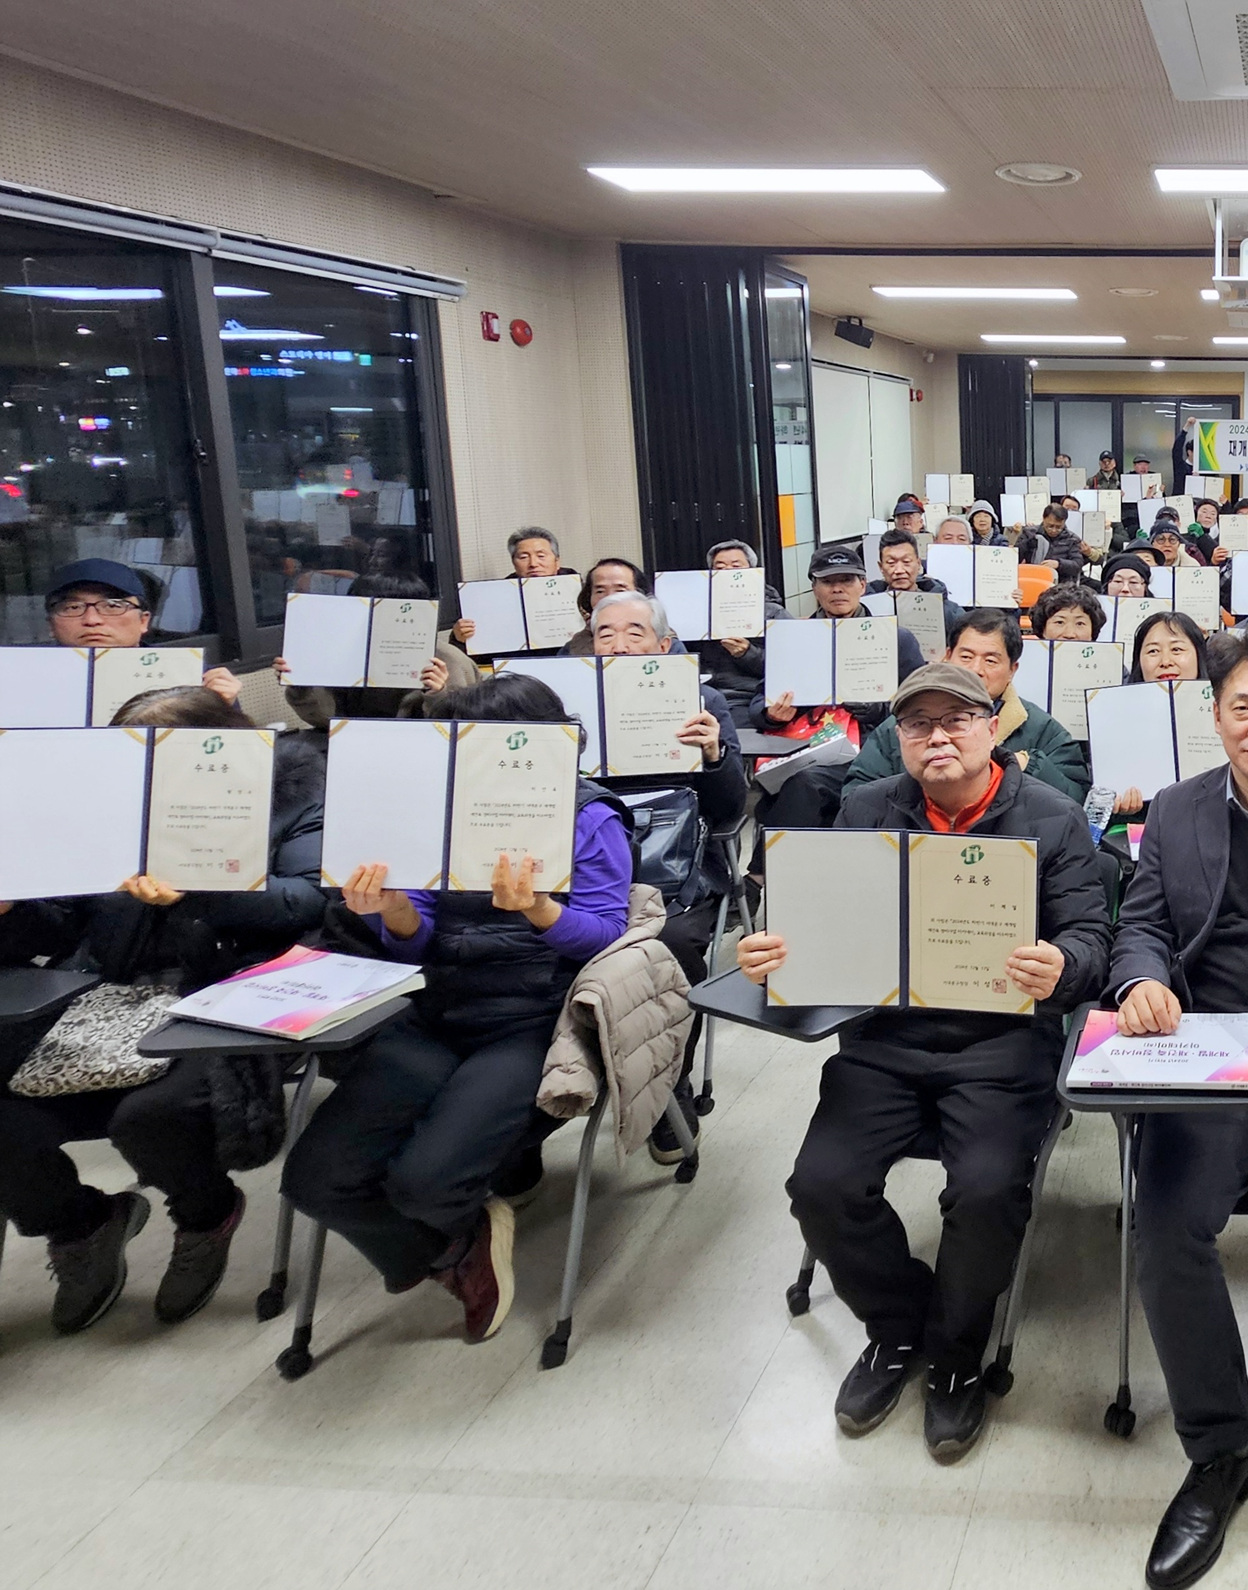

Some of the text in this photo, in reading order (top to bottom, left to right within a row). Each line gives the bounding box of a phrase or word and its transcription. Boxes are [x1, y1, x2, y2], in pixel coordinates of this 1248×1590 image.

[498, 760, 534, 770] 수료증
[953, 874, 992, 886] 수료증
[1109, 1049, 1153, 1057] 정비사업
